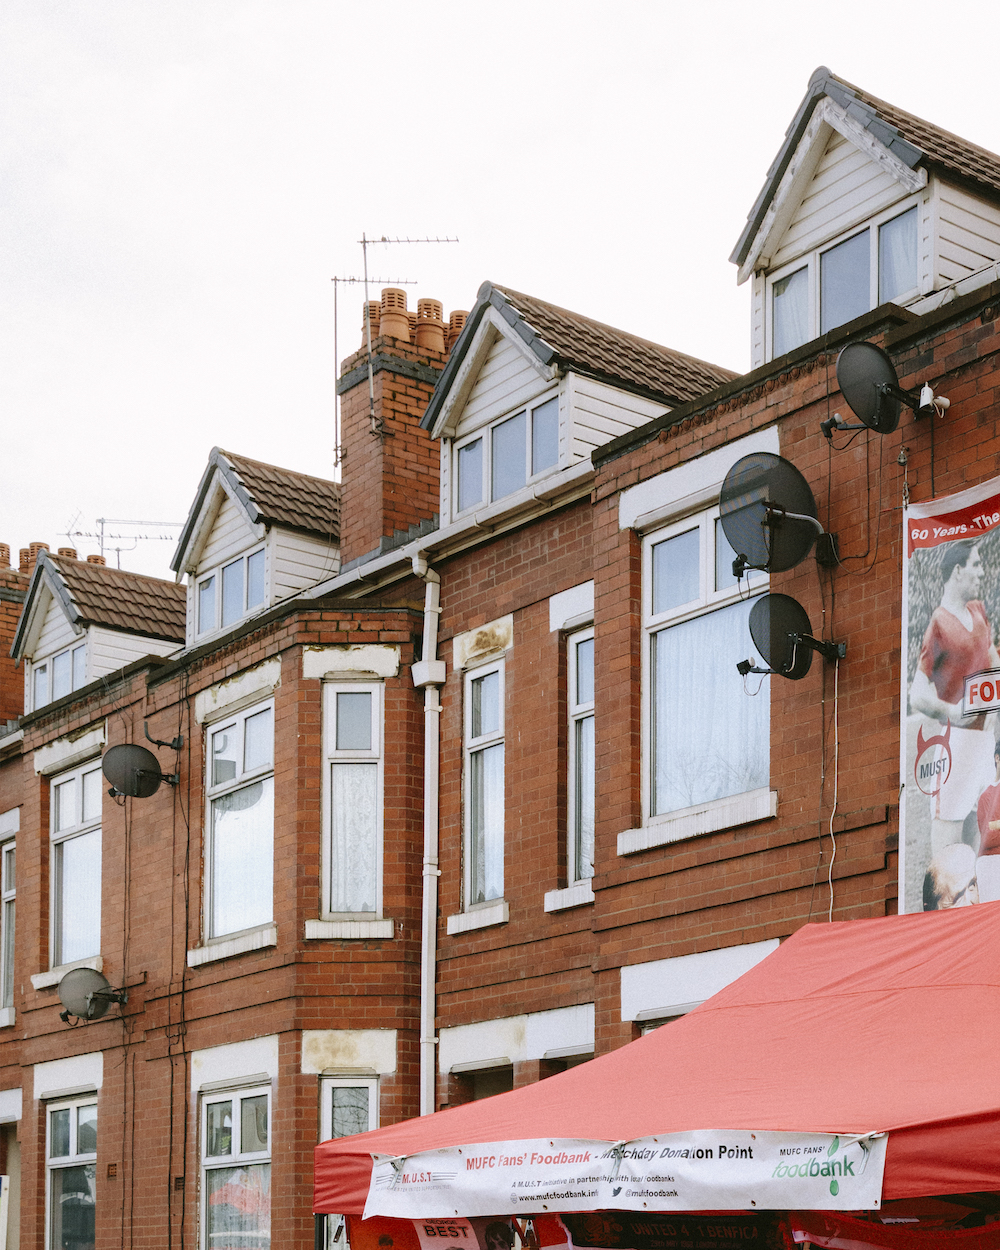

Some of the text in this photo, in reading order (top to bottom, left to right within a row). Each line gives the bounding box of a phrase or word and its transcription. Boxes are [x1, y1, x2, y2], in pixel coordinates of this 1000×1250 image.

[910, 528, 929, 541] 60
[932, 523, 968, 541] Years
[972, 510, 1000, 530] The
[920, 757, 948, 780] MUST
[466, 1155, 496, 1171] MUFC
[497, 1152, 528, 1168] Fans'
[530, 1150, 592, 1166] Foodbank
[718, 1144, 754, 1160] Point
[779, 1147, 802, 1157] MUFC
[402, 1171, 432, 1184] M.U.S.T
[771, 1157, 856, 1180] foodbank
[576, 1175, 614, 1185] partneship
[422, 1224, 470, 1239] BEST
[630, 1222, 678, 1237] UNITED
[706, 1225, 759, 1240] BENFICA
